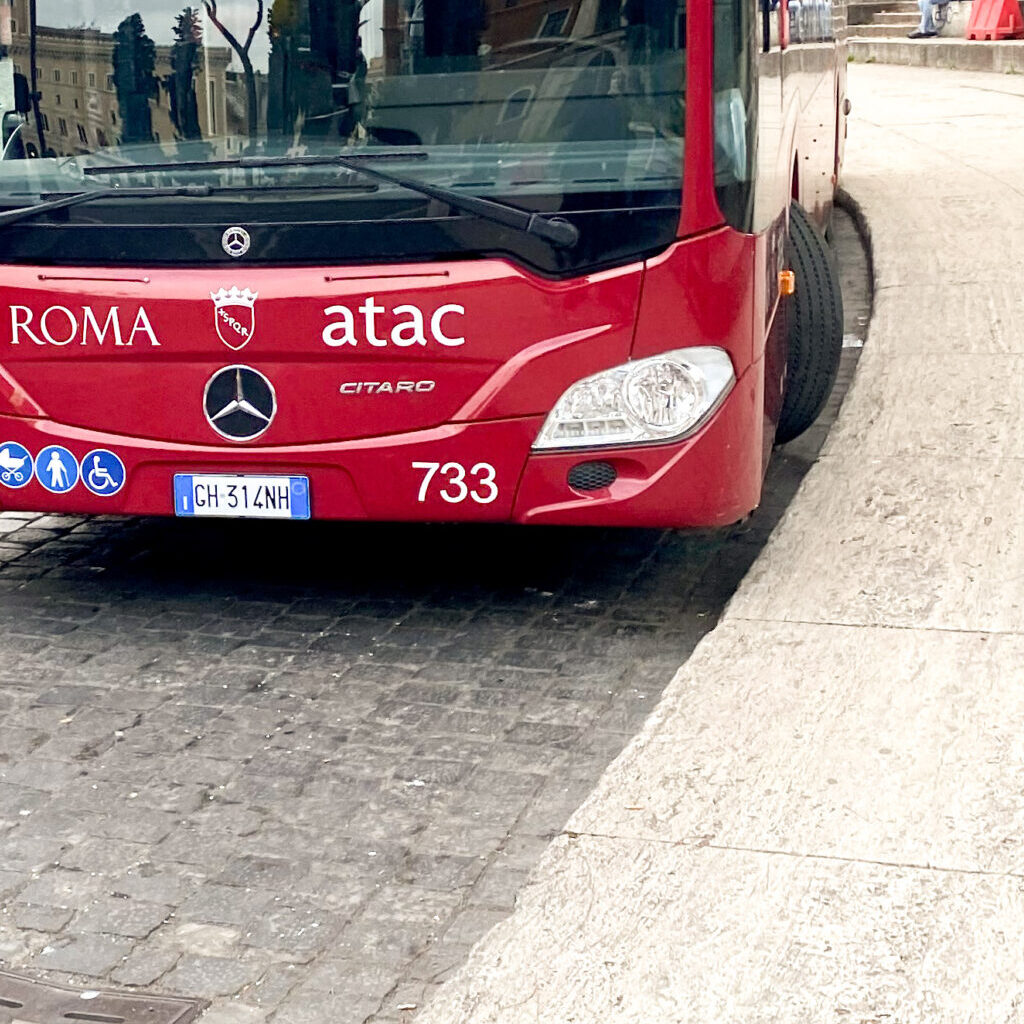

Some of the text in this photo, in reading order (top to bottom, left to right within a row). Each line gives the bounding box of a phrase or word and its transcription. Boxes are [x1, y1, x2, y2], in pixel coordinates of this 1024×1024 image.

[8, 305, 162, 346] ROMA
[321, 296, 466, 347] atac
[339, 380, 436, 394] CITARO
[411, 461, 499, 504] 733
